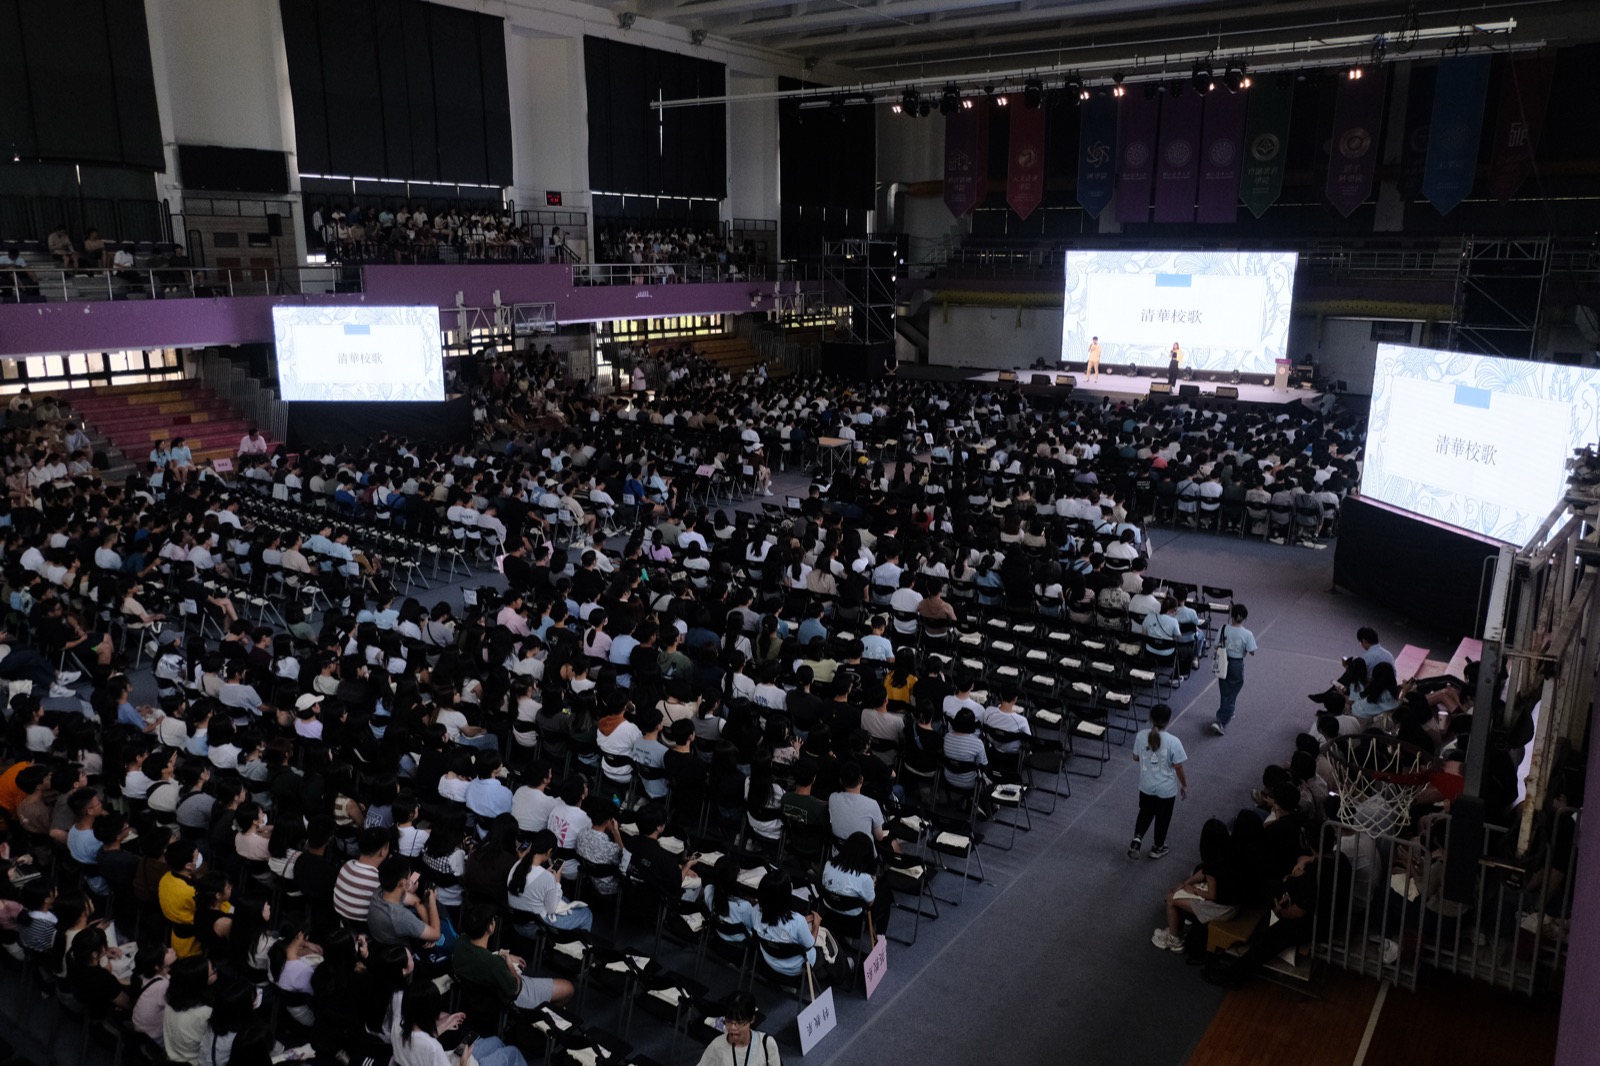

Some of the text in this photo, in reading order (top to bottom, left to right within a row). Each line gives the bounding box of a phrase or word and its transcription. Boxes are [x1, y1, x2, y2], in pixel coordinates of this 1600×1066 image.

[1140, 308, 1203, 325] 清華校歌
[337, 352, 384, 365] 清華校歌
[1436, 434, 1498, 467] 清華校歌
